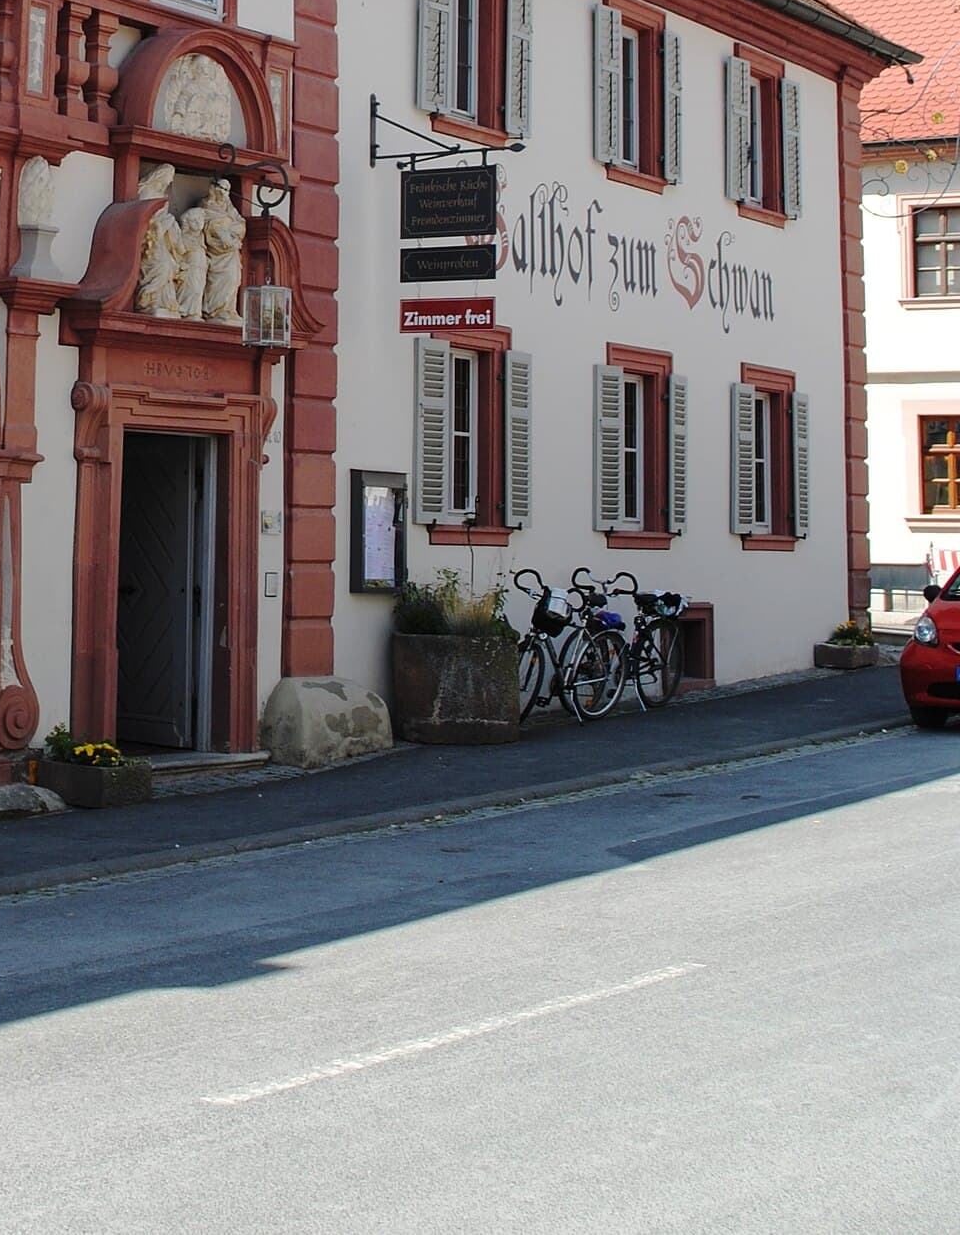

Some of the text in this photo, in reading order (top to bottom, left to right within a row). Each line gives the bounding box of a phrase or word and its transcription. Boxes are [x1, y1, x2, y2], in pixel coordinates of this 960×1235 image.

[460, 173, 489, 191] Küche
[410, 210, 486, 226] Fremdenzimmer
[607, 232, 658, 312] zum
[664, 215, 775, 334] Schwan
[403, 308, 491, 327] Zimmer frei
